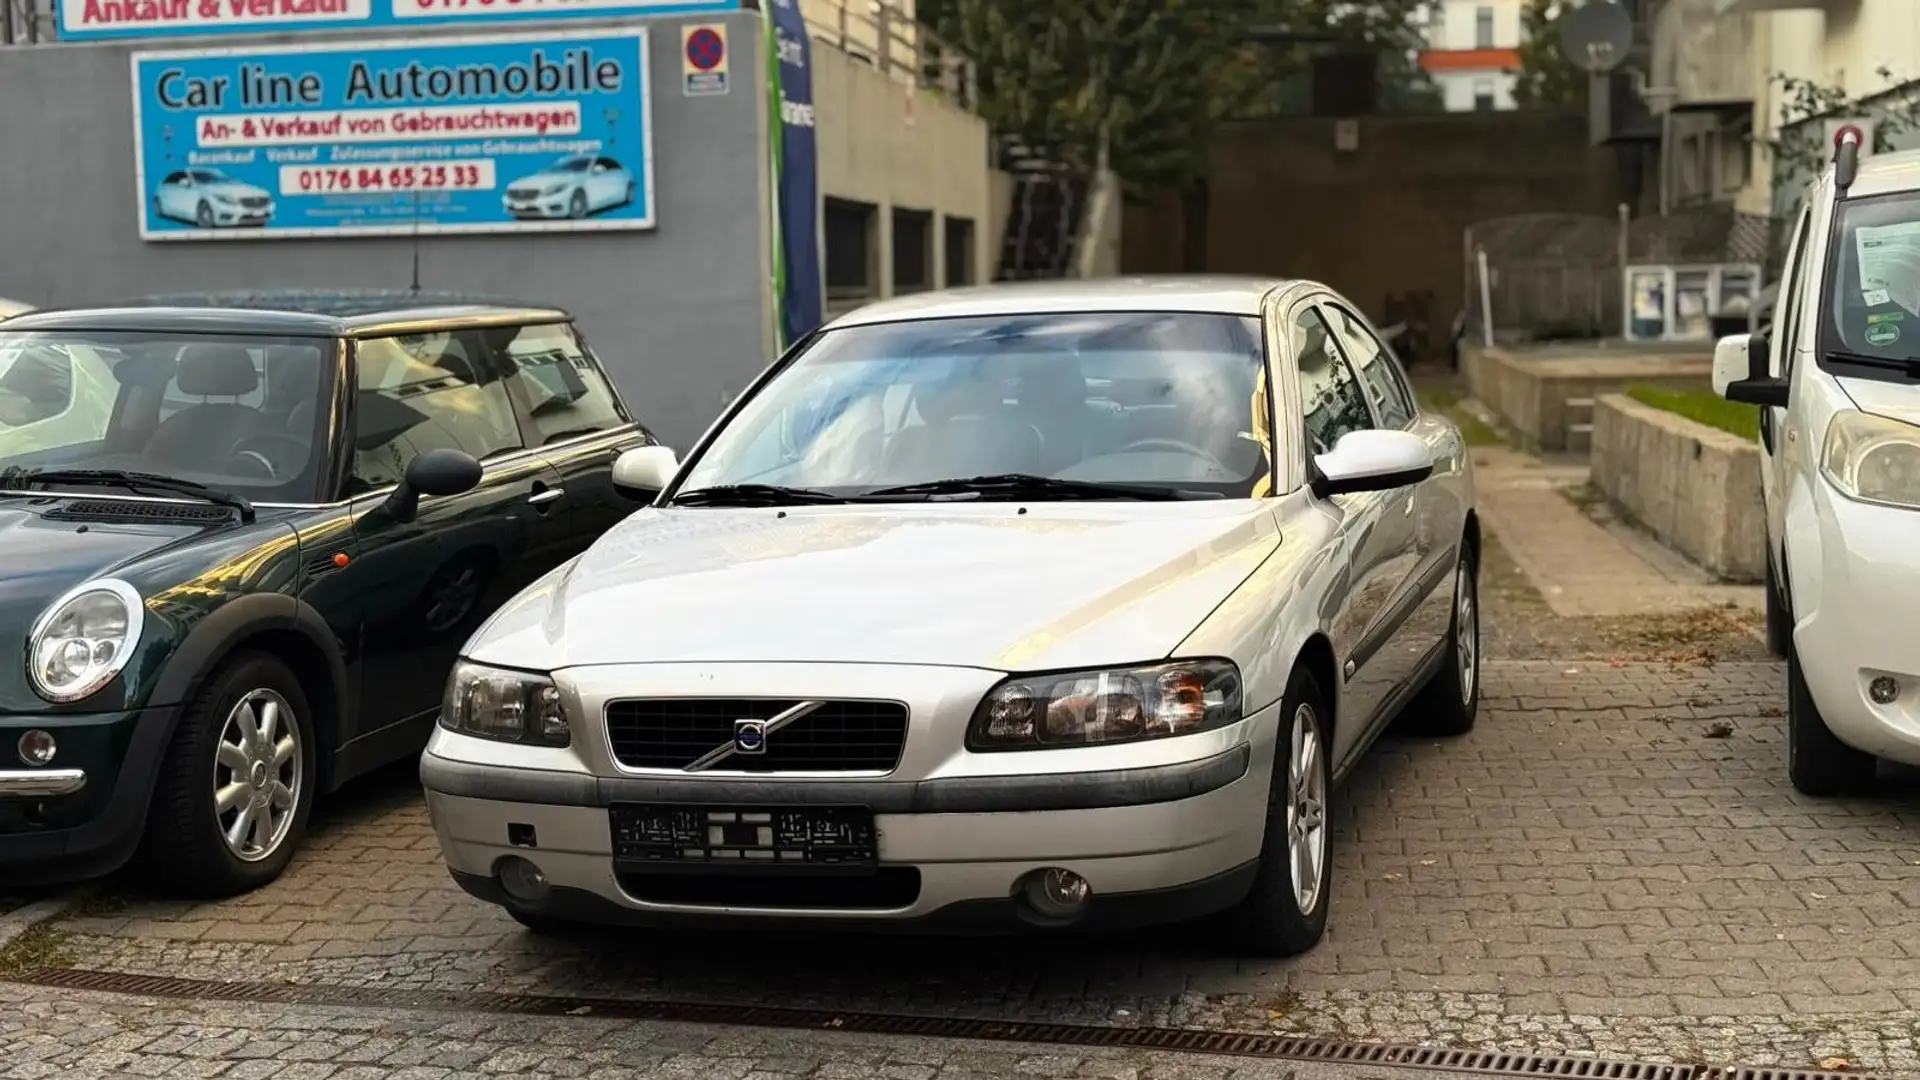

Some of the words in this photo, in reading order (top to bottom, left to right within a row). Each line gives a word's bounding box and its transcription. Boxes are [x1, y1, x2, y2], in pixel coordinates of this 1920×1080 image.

[157, 70, 227, 109] Car
[240, 65, 322, 105] line
[346, 50, 622, 101] Automobile
[202, 119, 236, 140] An-
[242, 119, 256, 138] &
[260, 113, 343, 136] Verkauf
[347, 117, 385, 134] von
[391, 107, 577, 133] Gebrauchtwagen
[299, 169, 351, 190] 0176
[357, 168, 384, 187] 84
[389, 167, 415, 187] 65
[421, 167, 447, 186] 25
[452, 166, 479, 184] 33
